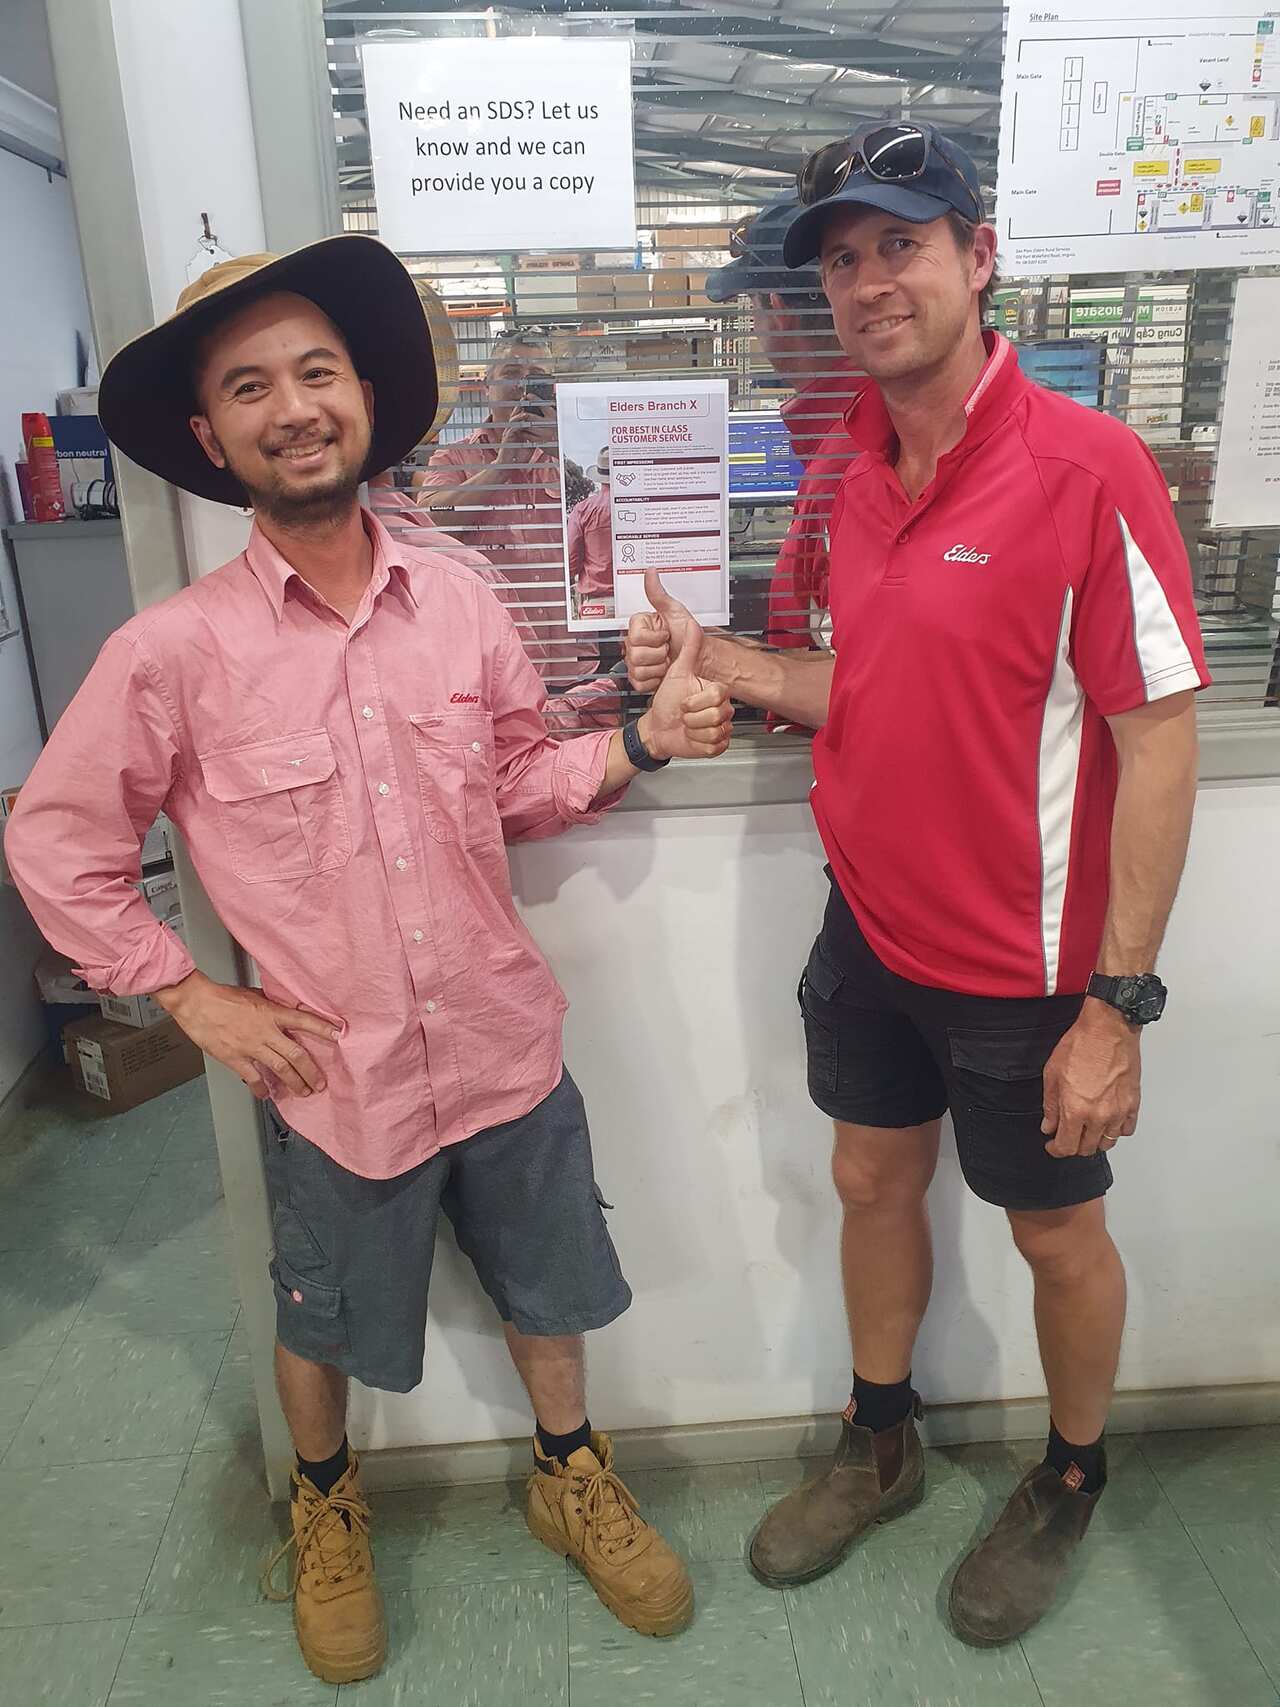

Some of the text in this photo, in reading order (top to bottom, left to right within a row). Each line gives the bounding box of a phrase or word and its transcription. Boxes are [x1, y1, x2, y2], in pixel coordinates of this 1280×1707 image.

[399, 100, 599, 121] Need an SDS? Let us
[416, 136, 585, 156] know and we can
[411, 172, 595, 196] provide you a copy
[609, 399, 697, 412] Elders Branch X
[611, 424, 688, 435] FOR BEST IN CLASS
[611, 433, 693, 444] CUSTOMER SERVICE
[76, 448, 107, 457] neutral
[450, 692, 480, 704] Elders
